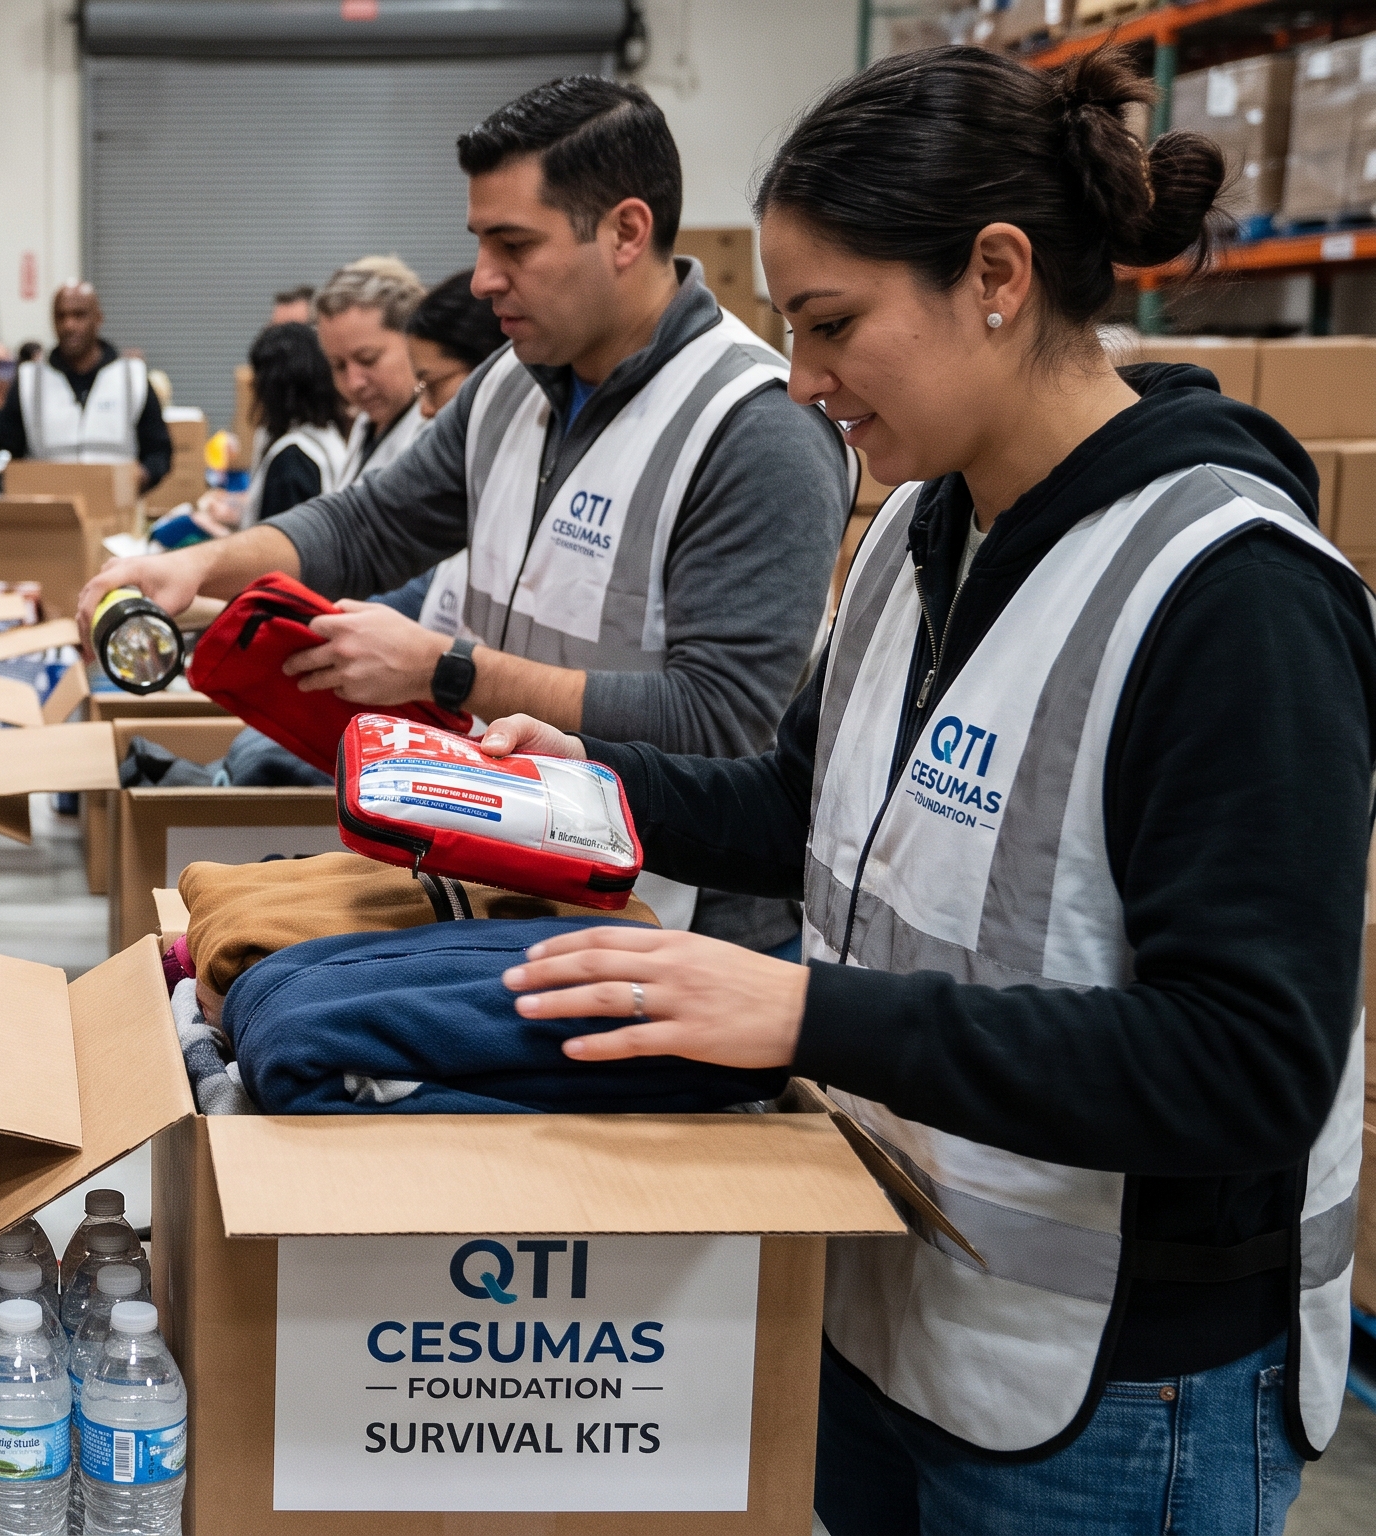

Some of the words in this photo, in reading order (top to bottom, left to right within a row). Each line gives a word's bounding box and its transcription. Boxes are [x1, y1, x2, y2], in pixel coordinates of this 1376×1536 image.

[570, 491, 612, 527] QTI
[552, 518, 611, 549] CESUMAS
[930, 715, 998, 778] QTI
[911, 759, 1002, 814] CESUMAS
[914, 791, 977, 828] FOUNDATION
[449, 1239, 588, 1305] QTI
[367, 1321, 665, 1363] CESUMAS
[409, 1377, 622, 1399] FOUNDATION
[365, 1422, 563, 1453] SURVIVAL
[577, 1422, 660, 1453] KITS
